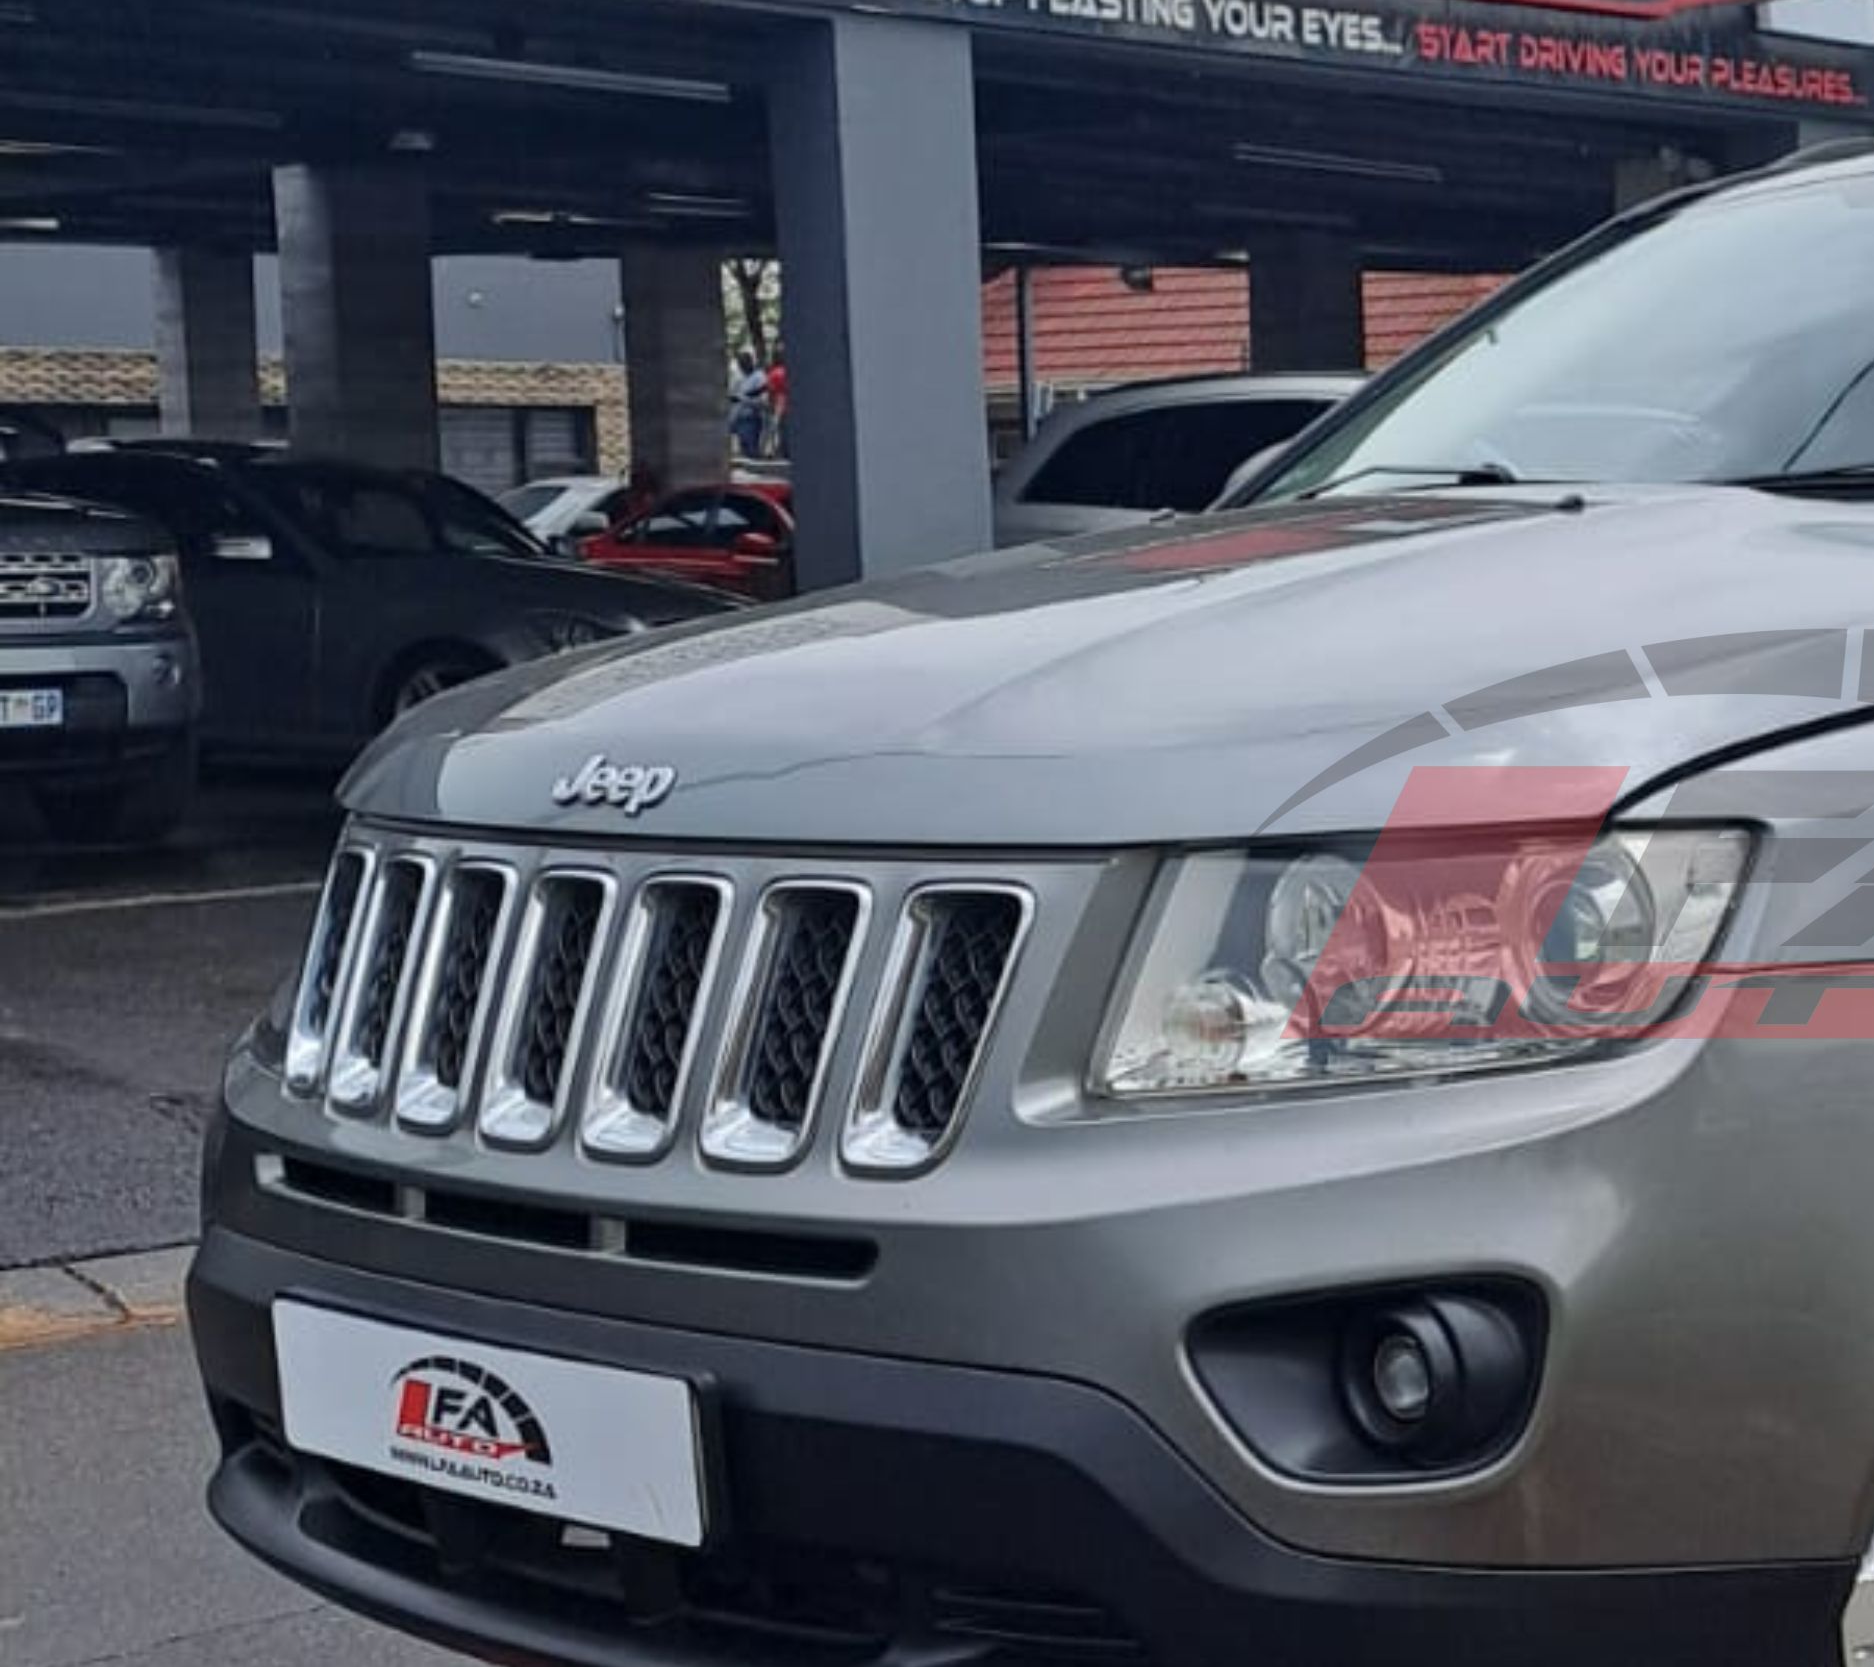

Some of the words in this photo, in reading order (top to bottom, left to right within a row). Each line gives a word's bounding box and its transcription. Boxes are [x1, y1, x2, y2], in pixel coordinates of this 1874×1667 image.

[1417, 23, 1510, 65] START
[1519, 35, 1626, 80] DRIVING
[1634, 47, 1703, 86] YOUR
[552, 753, 676, 818] Jeep
